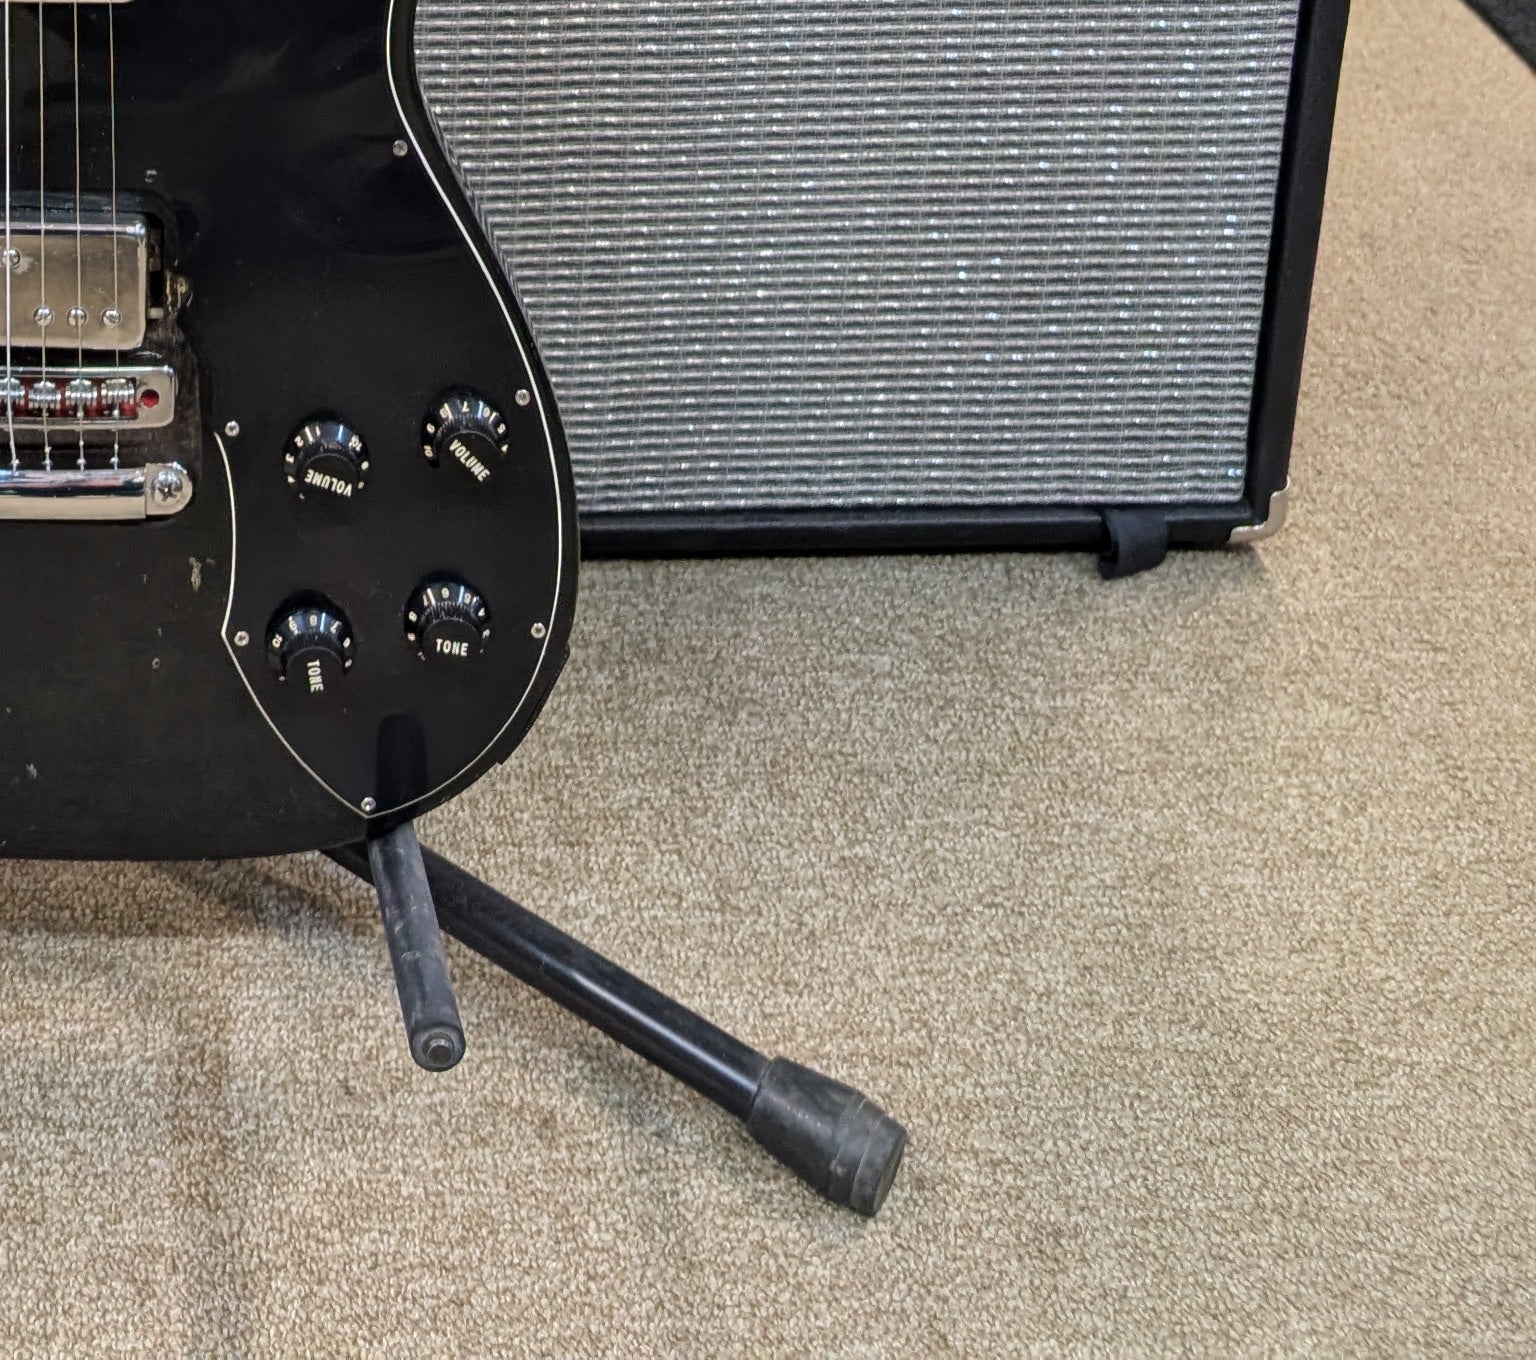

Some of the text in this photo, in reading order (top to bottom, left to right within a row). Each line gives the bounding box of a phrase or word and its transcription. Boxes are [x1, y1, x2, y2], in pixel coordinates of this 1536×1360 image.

[449, 439, 491, 482] VOLUME
[304, 469, 353, 497] VOLUME
[436, 638, 469, 657] TONE
[306, 659, 324, 693] TONE
